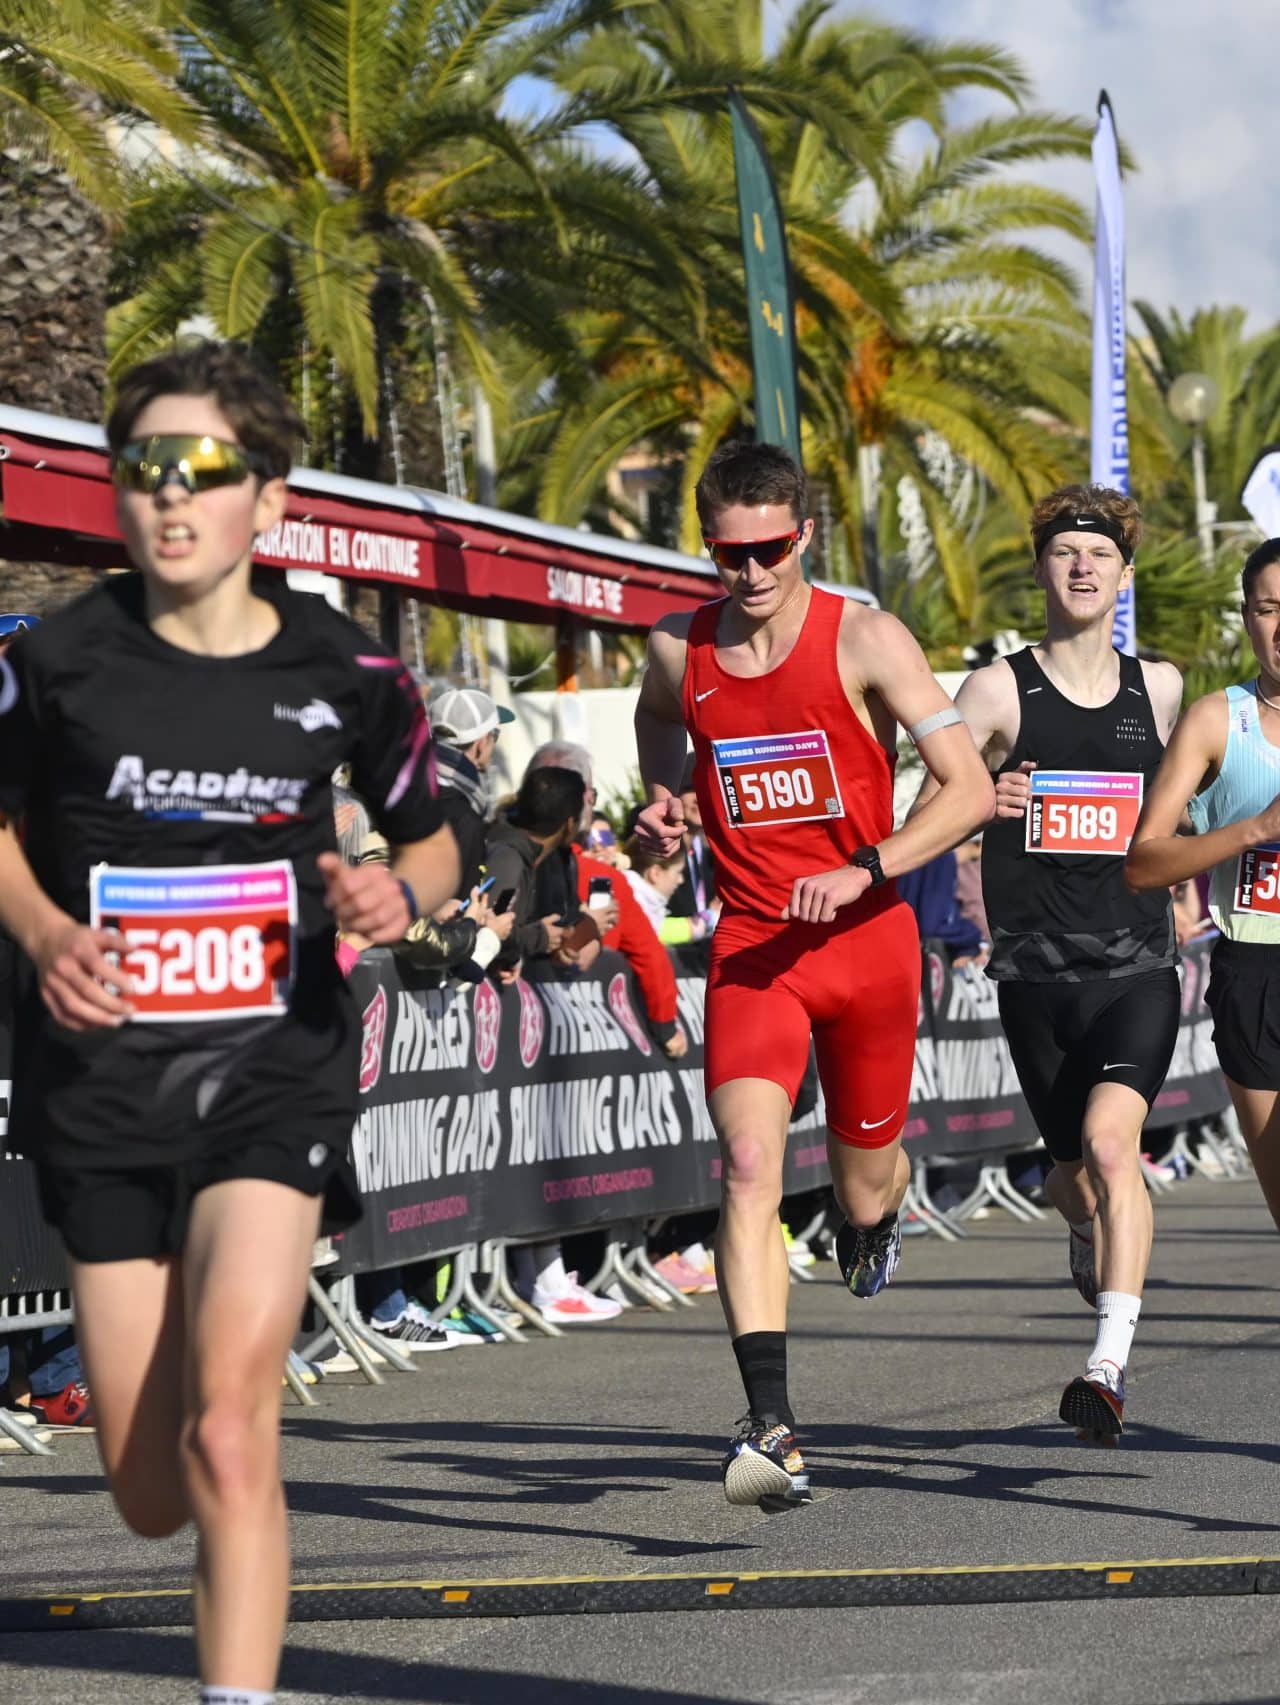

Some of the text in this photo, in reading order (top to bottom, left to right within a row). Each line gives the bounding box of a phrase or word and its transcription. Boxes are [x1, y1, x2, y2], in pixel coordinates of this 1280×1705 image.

[252, 521, 420, 578] AURATION EN CONTINUE
[547, 566, 584, 606] SALON
[583, 573, 605, 609] DE
[795, 741, 818, 750] DAYS
[724, 776, 739, 817] PREF
[740, 768, 815, 811] 5190
[1033, 803, 1042, 841] PREF
[1048, 804, 1117, 840] 5189
[125, 925, 266, 996] 5208
[446, 1089, 501, 1176] DAYS
[509, 1075, 615, 1166] RUNNING
[617, 1070, 682, 1151] DAYS
